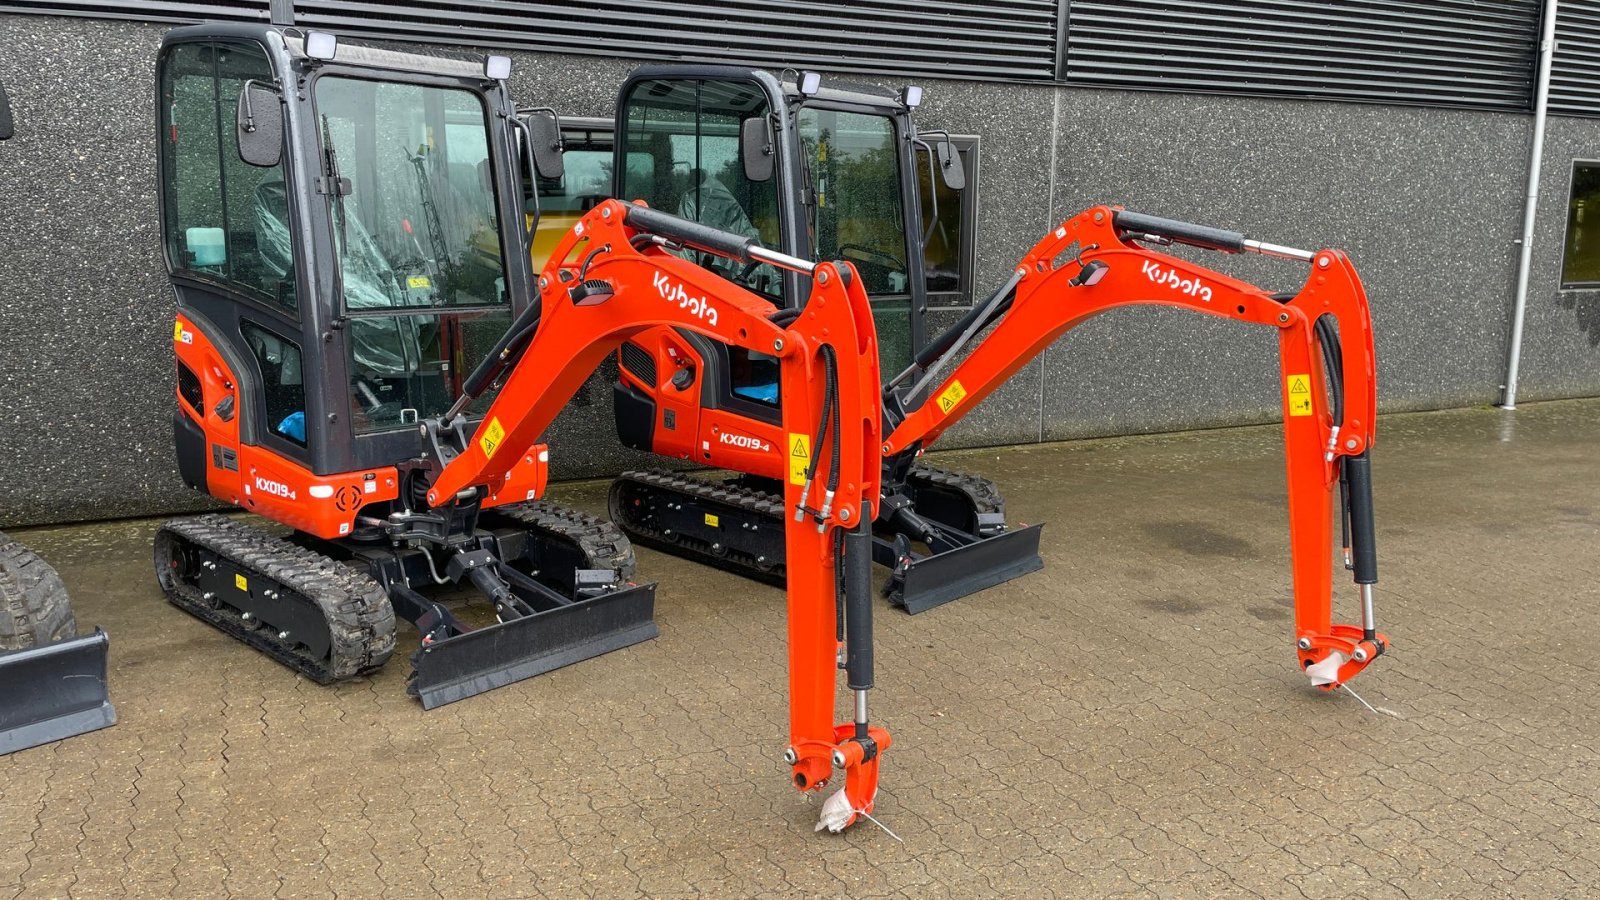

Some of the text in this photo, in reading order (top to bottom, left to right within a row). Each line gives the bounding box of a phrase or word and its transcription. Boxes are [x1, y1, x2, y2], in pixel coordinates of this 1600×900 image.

[1142, 260, 1212, 302] Kubota
[653, 270, 718, 326] Kubota
[720, 432, 770, 452] KX019-4
[256, 477, 296, 500] KX019-4
